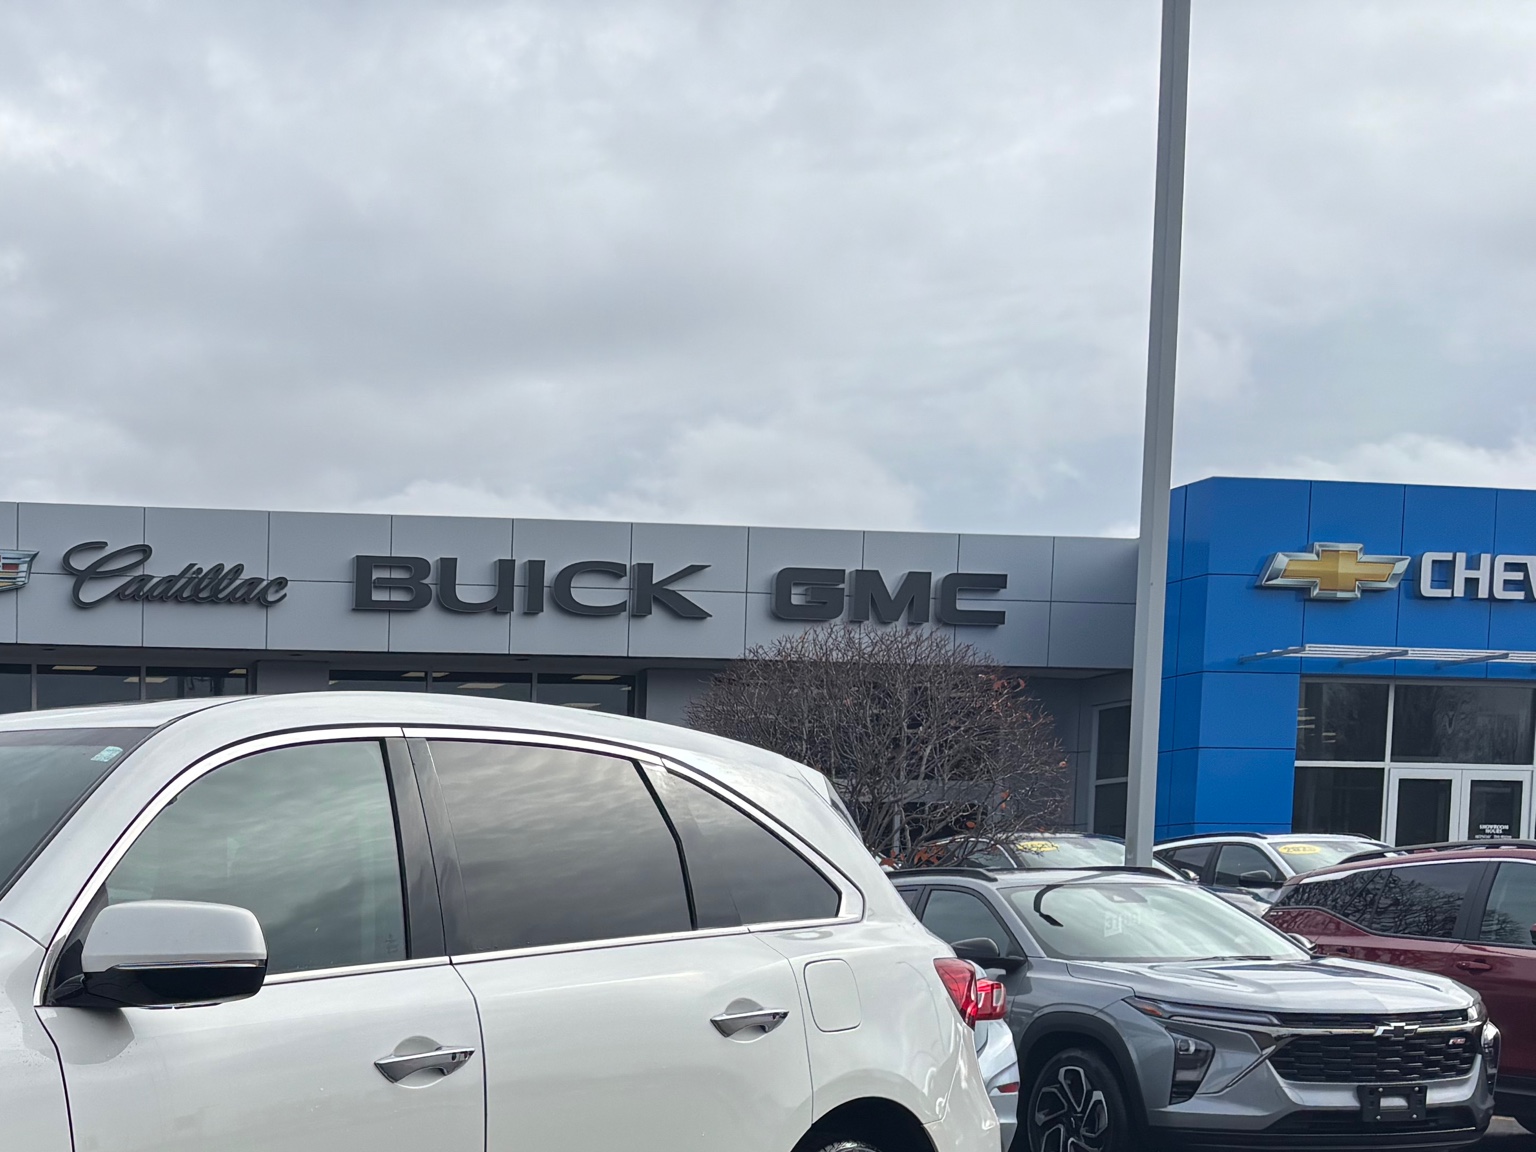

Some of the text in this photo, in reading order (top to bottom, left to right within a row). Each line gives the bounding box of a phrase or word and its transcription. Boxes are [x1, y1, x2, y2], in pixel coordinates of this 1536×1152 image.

[62, 540, 289, 610] Cadillac
[351, 554, 713, 620] BUICK
[770, 566, 1009, 626] GMC
[1420, 551, 1536, 600] CHE
